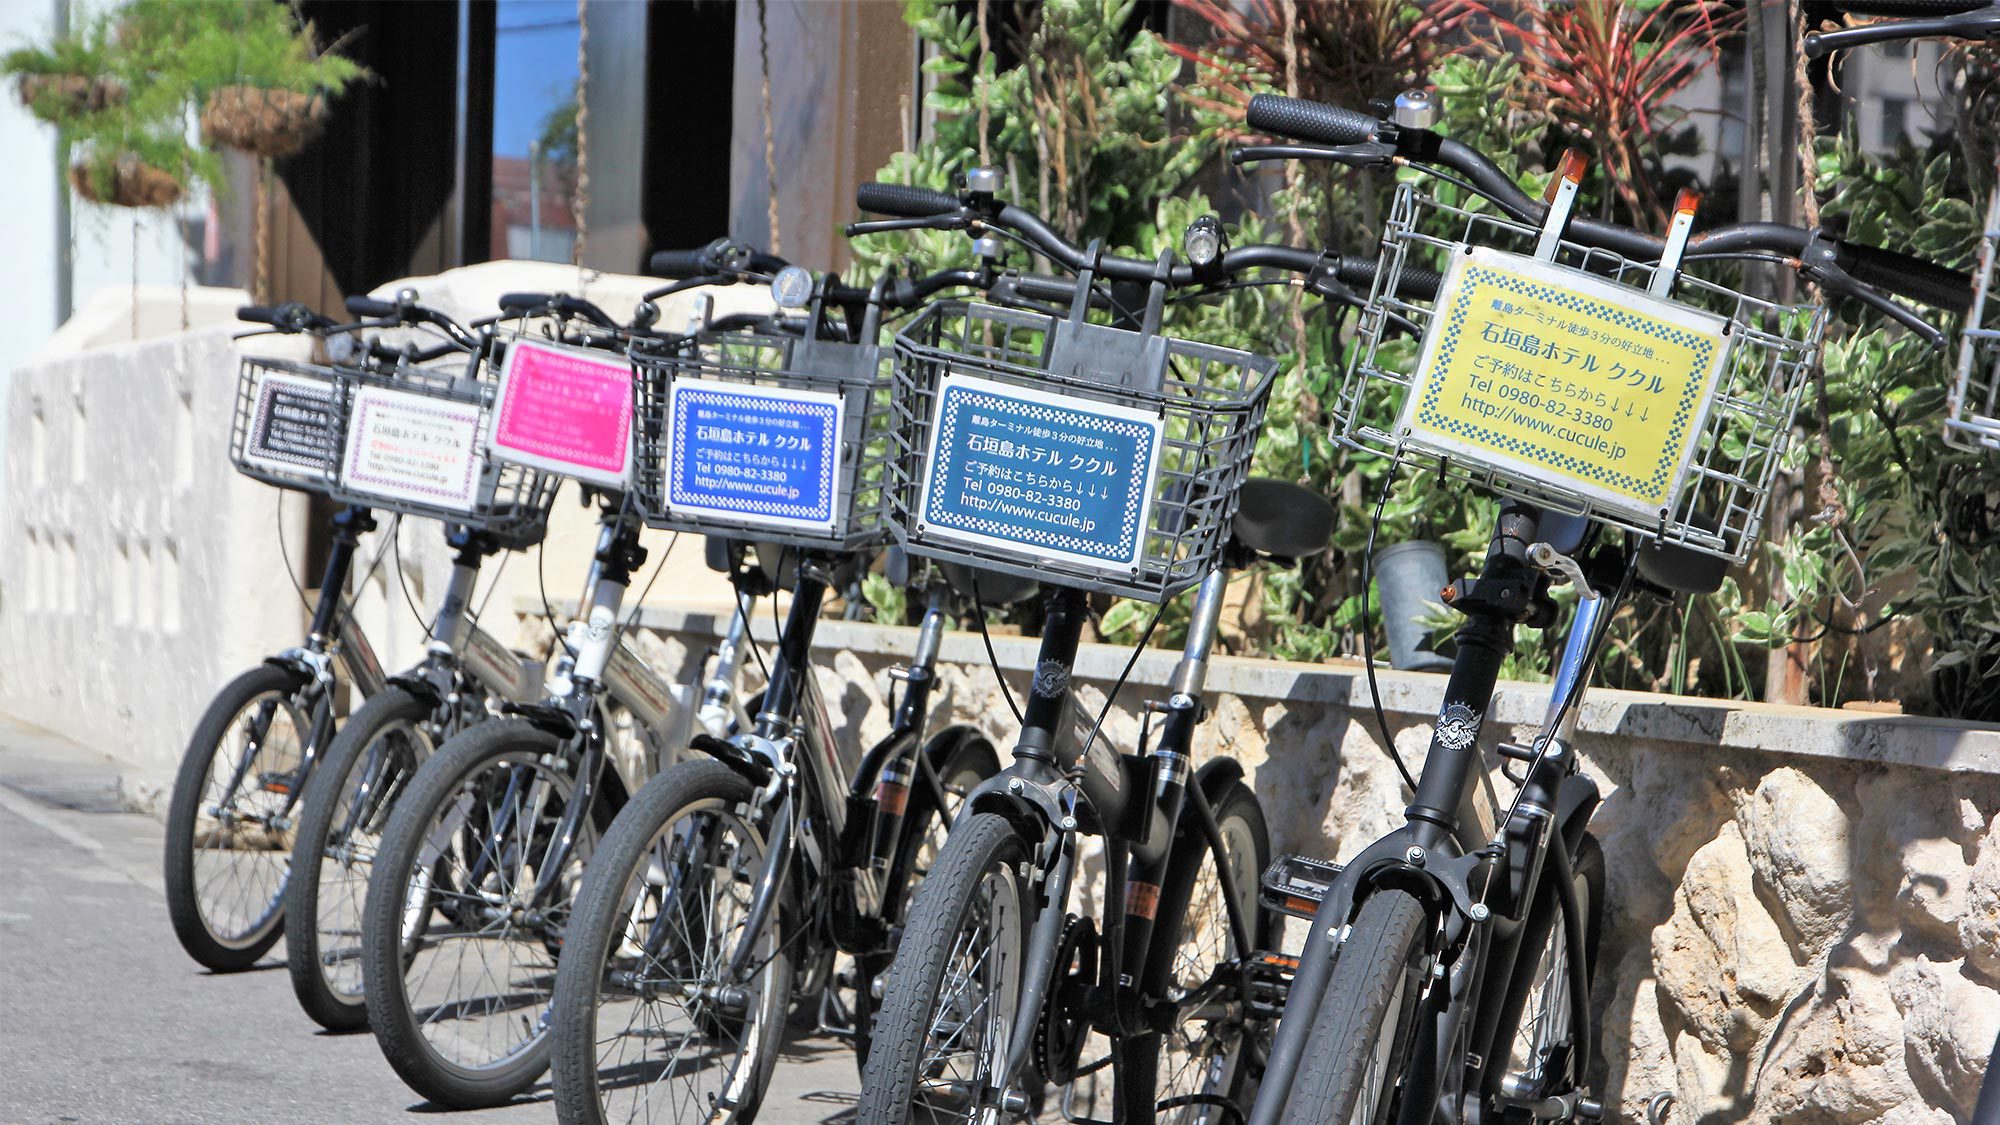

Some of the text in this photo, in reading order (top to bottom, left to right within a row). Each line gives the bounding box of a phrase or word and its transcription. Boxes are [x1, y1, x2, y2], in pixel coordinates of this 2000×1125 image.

[1480, 320, 1666, 395] 石垣島ホテル ククル
[1472, 353, 1608, 409] ご予約はこちらから
[1469, 374, 1614, 433] Tel 0980-82-3380
[696, 426, 812, 451] 石垣島ホテル ククル
[1461, 393, 1627, 461] http://www.cucule.jp
[696, 462, 787, 483] Tel 0980-82-3380
[966, 432, 1118, 477] 石垣島ホテル ククル
[694, 475, 800, 500] http://www.cucule.jp
[963, 477, 1081, 512] Tel 0980-82-3380
[964, 460, 1073, 493] ご予約はこちらから
[960, 492, 1096, 533] http://www.cucule.jp
